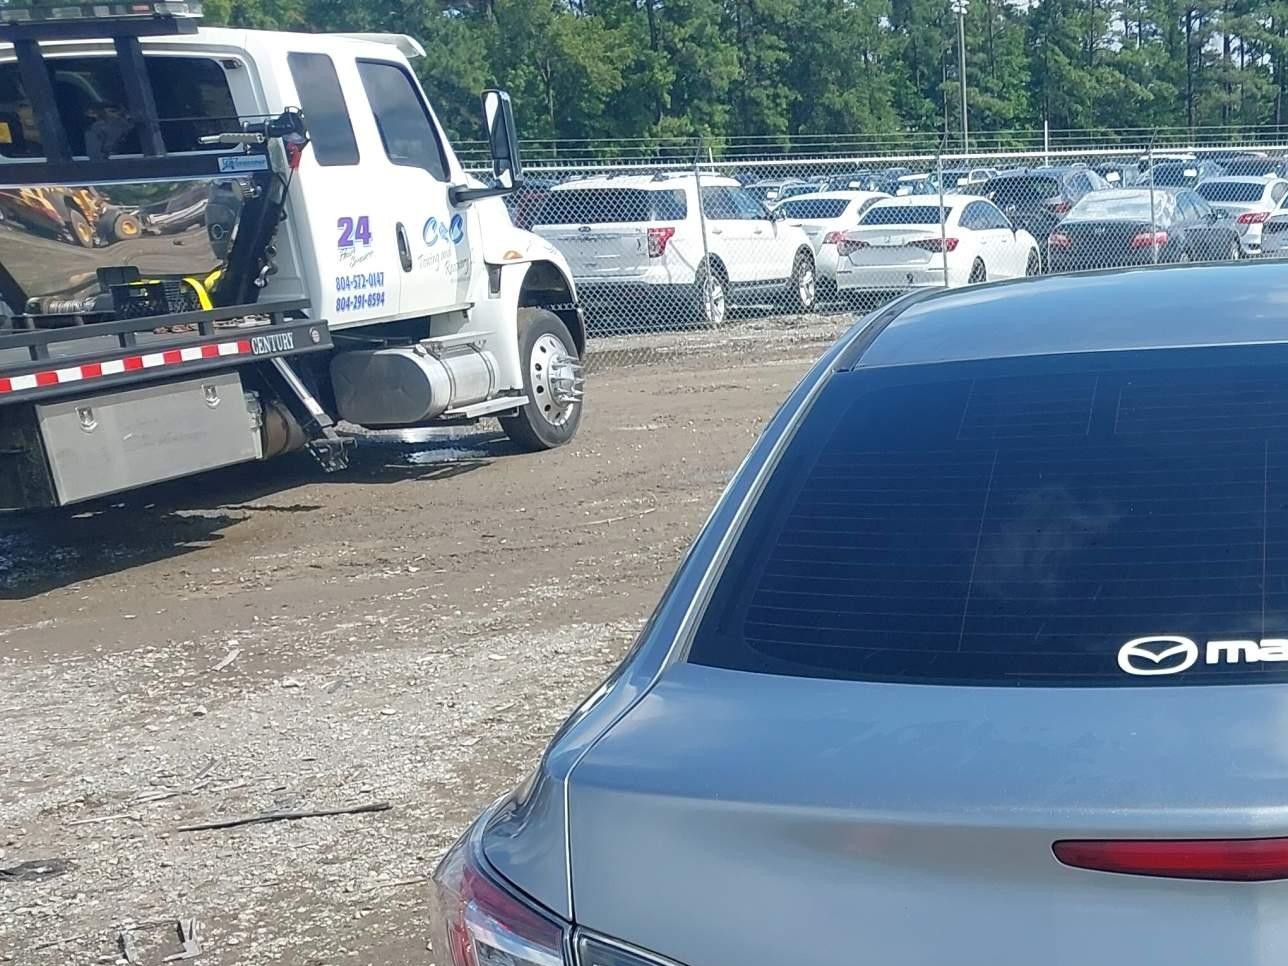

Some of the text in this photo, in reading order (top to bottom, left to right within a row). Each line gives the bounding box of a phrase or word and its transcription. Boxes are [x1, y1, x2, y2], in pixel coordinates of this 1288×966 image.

[337, 215, 373, 248] 24
[335, 271, 385, 292] 804-572-0147
[335, 291, 385, 313] 804-291-8594
[251, 332, 295, 356] CENTURY
